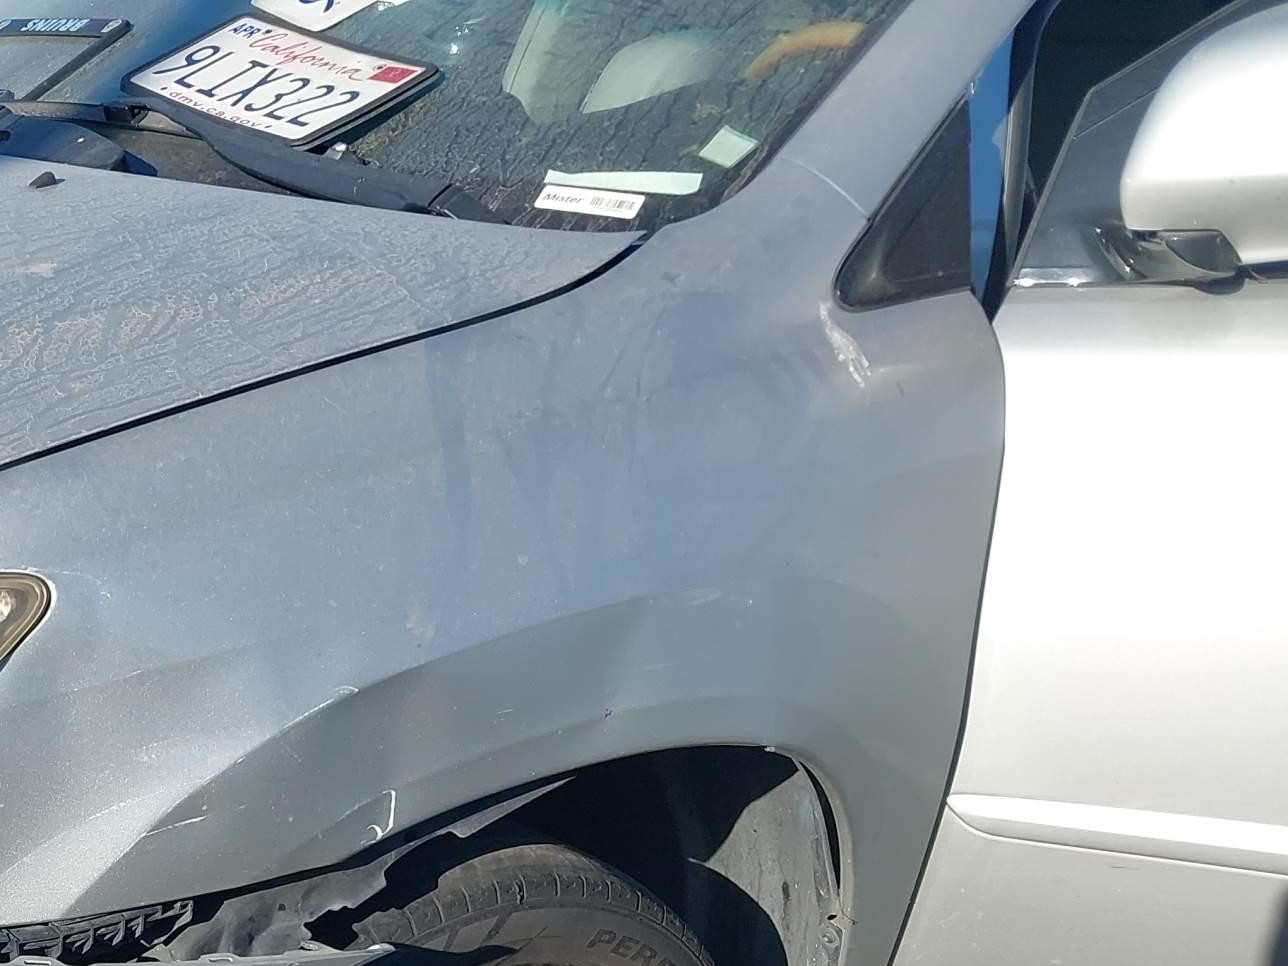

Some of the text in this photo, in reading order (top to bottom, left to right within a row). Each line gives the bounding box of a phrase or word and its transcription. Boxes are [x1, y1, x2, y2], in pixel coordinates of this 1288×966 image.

[20, 18, 91, 32] BRUINS
[228, 23, 262, 39] APR
[248, 33, 365, 81] California
[152, 45, 361, 126] 9LIX322
[169, 89, 265, 128] dmv.ca.gov
